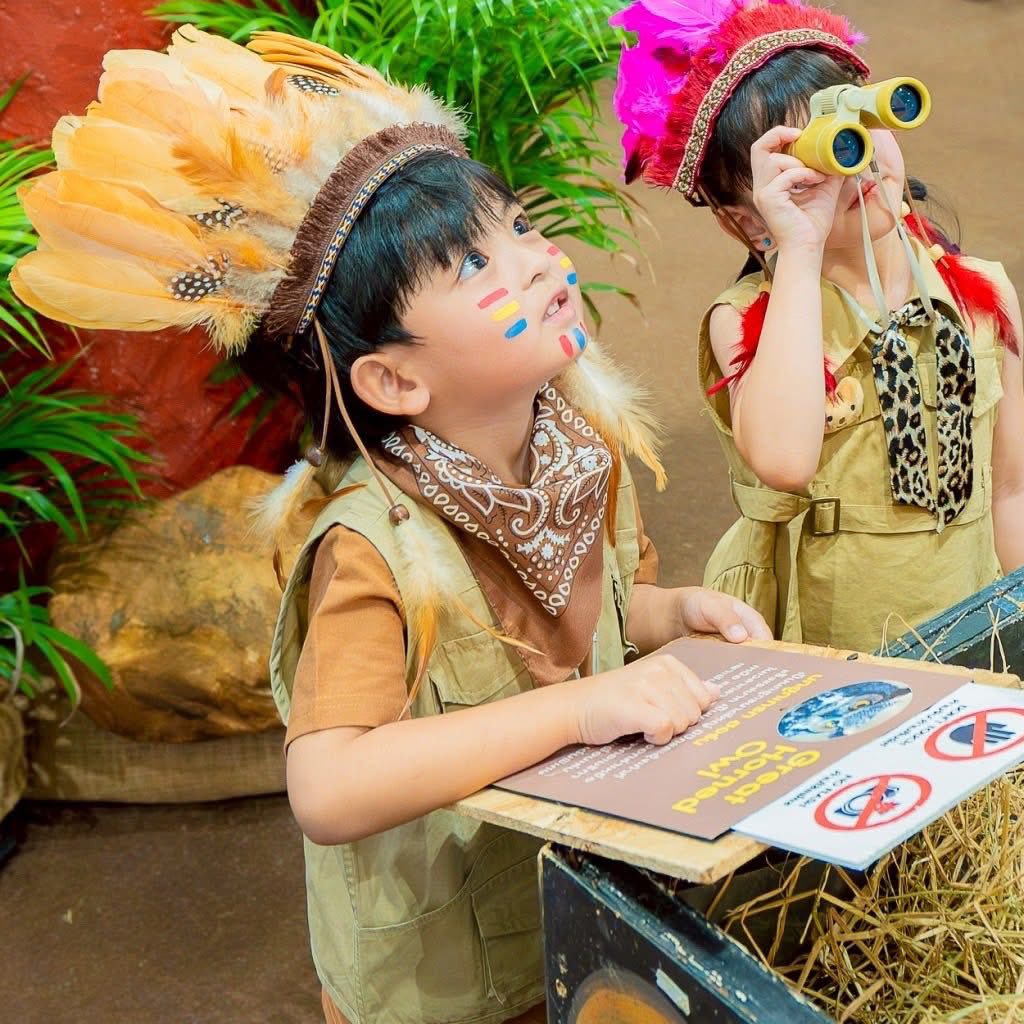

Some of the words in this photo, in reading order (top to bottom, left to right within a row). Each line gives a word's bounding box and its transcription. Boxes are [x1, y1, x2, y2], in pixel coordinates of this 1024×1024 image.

[671, 744, 798, 814] Horned
[696, 740, 768, 778] Owl
[723, 749, 821, 805] Great
